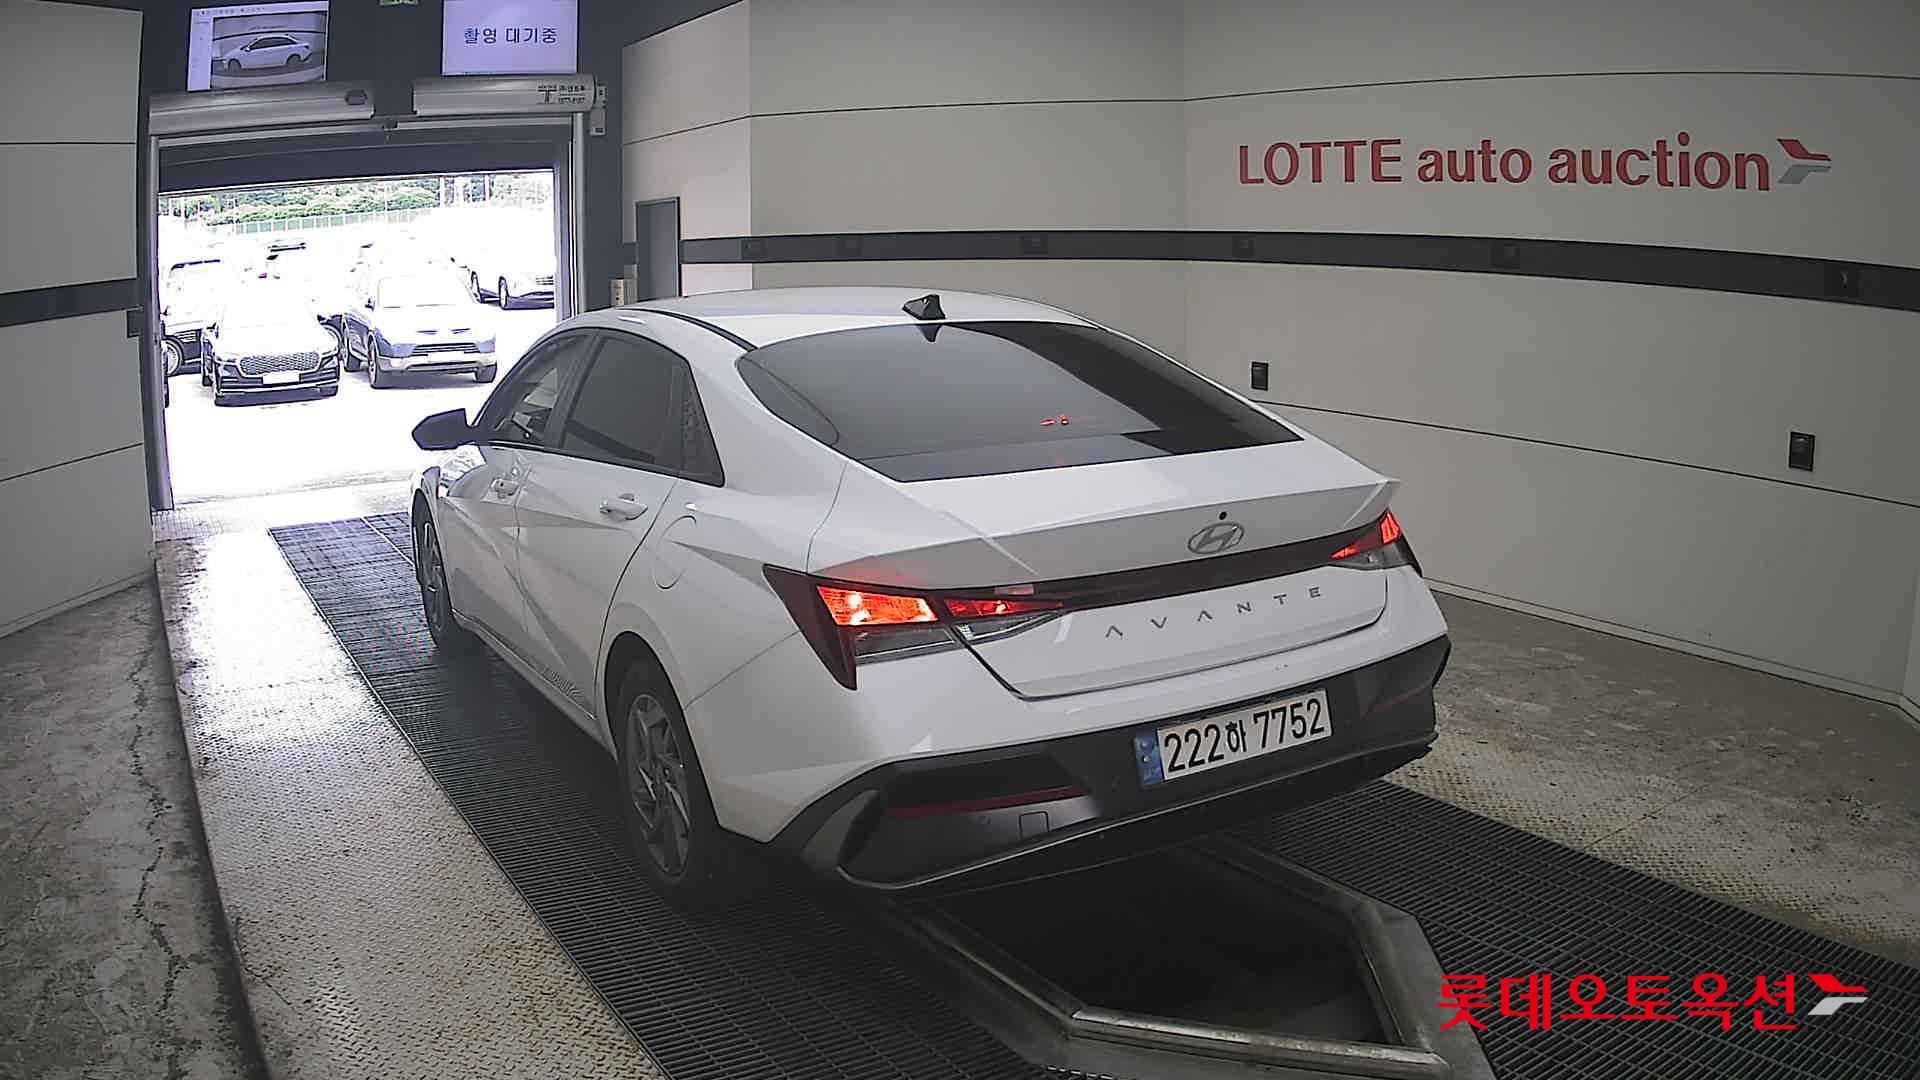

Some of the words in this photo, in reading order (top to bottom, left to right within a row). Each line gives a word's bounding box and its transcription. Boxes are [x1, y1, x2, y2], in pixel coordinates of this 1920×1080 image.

[463, 27, 497, 44] 촬영
[505, 27, 558, 44] 대기중
[1238, 137, 1402, 186] LOTTE
[1417, 139, 1533, 184] auto
[1547, 131, 1770, 191] auction
[1105, 585, 1322, 639] AVANTE
[1164, 719, 1247, 774] 222하
[1253, 698, 1325, 749] 7752
